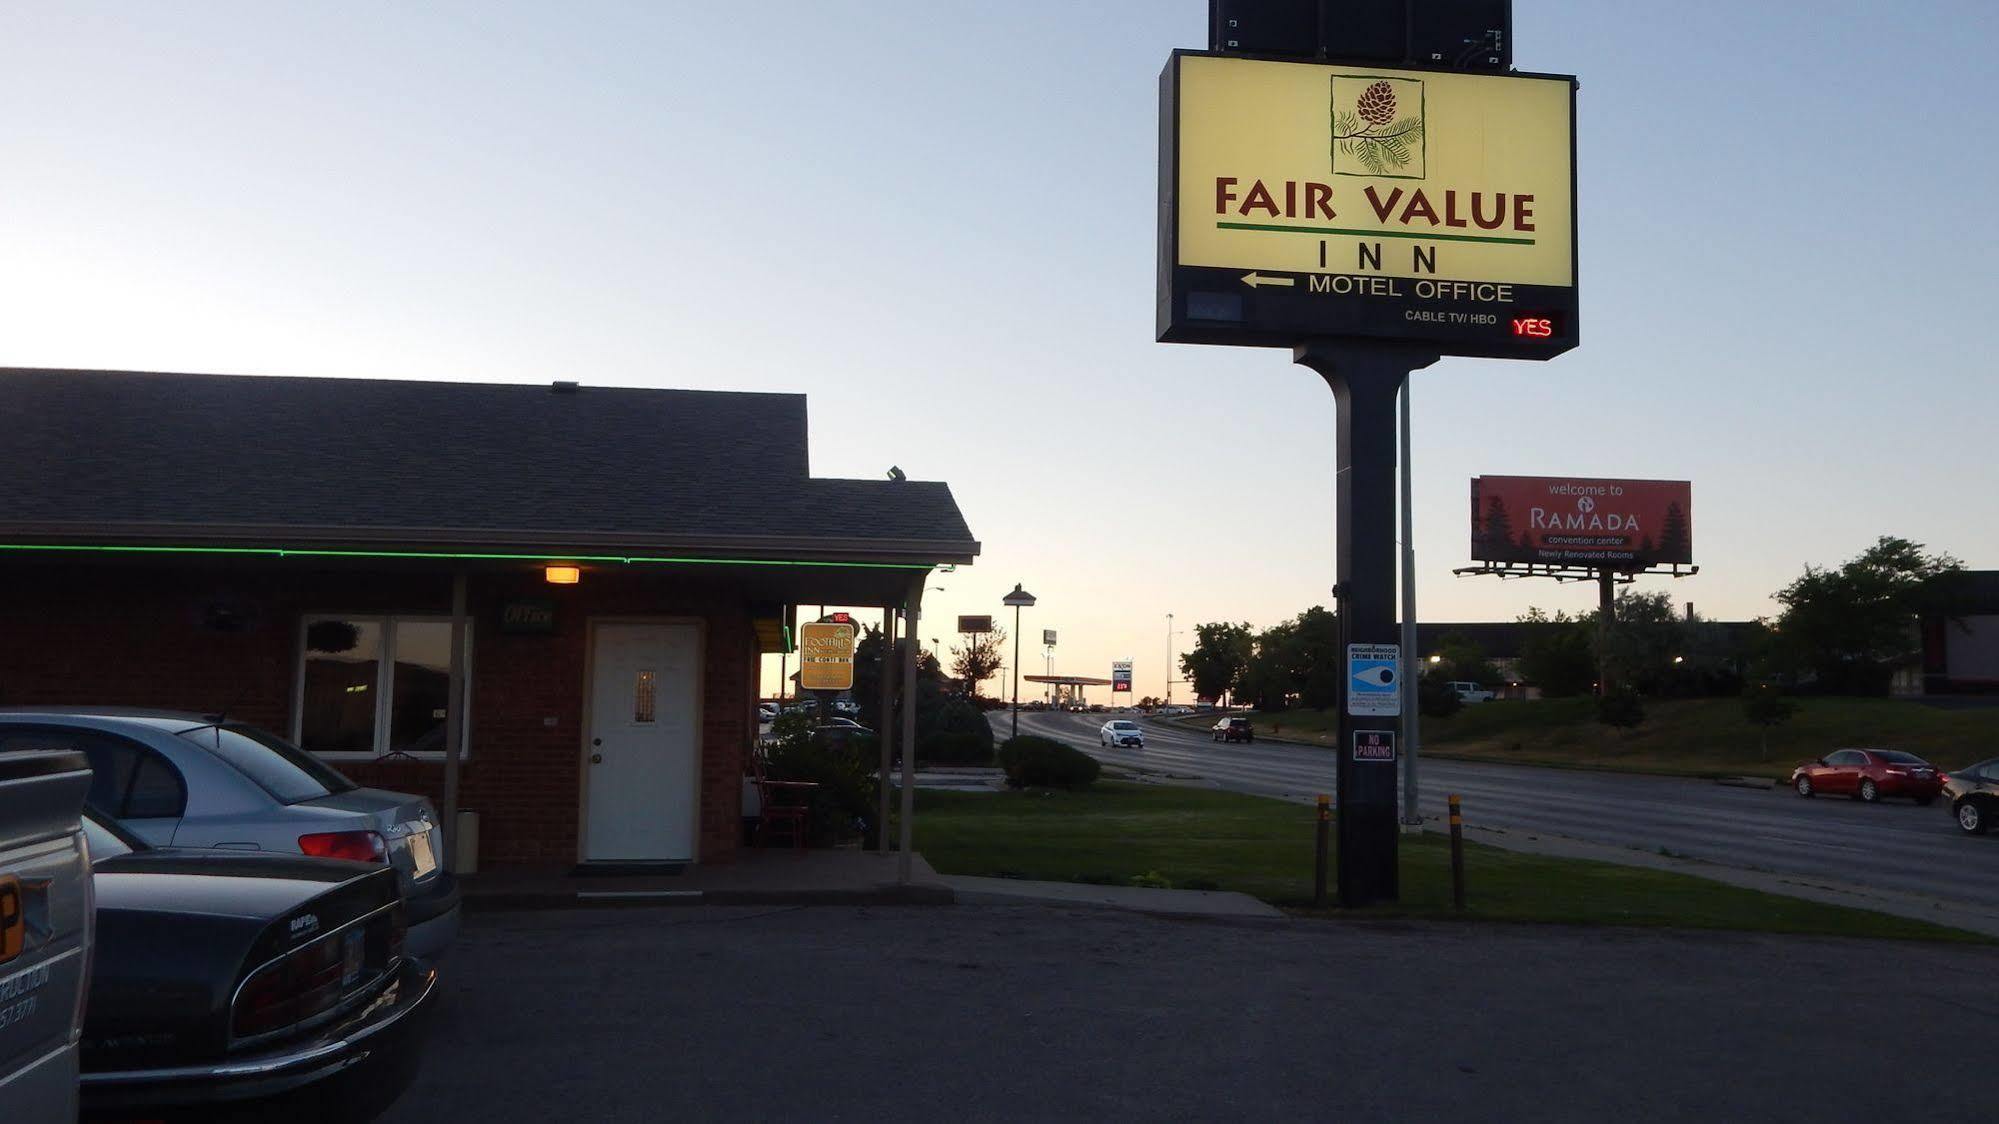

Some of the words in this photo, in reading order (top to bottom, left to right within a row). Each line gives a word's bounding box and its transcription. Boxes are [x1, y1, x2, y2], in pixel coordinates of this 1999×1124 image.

[1216, 177, 1337, 221] FAIR
[1363, 185, 1536, 232] VALUE
[1319, 240, 1436, 273] INN
[1309, 275, 1402, 297] MOTEL
[1415, 280, 1514, 303] OFFICE
[1405, 310, 1446, 323] CABLE
[1470, 313, 1497, 325] HBO
[1513, 318, 1553, 338] YES
[1549, 483, 1606, 496] welcome
[1610, 484, 1623, 496] to
[1530, 507, 1640, 531] RAMADA
[1548, 536, 1595, 545] convention
[1596, 537, 1624, 545] center
[1607, 551, 1634, 559] Rooms
[834, 613, 849, 622] YES
[1368, 734, 1380, 745] NO
[1357, 745, 1392, 757] PARKING
